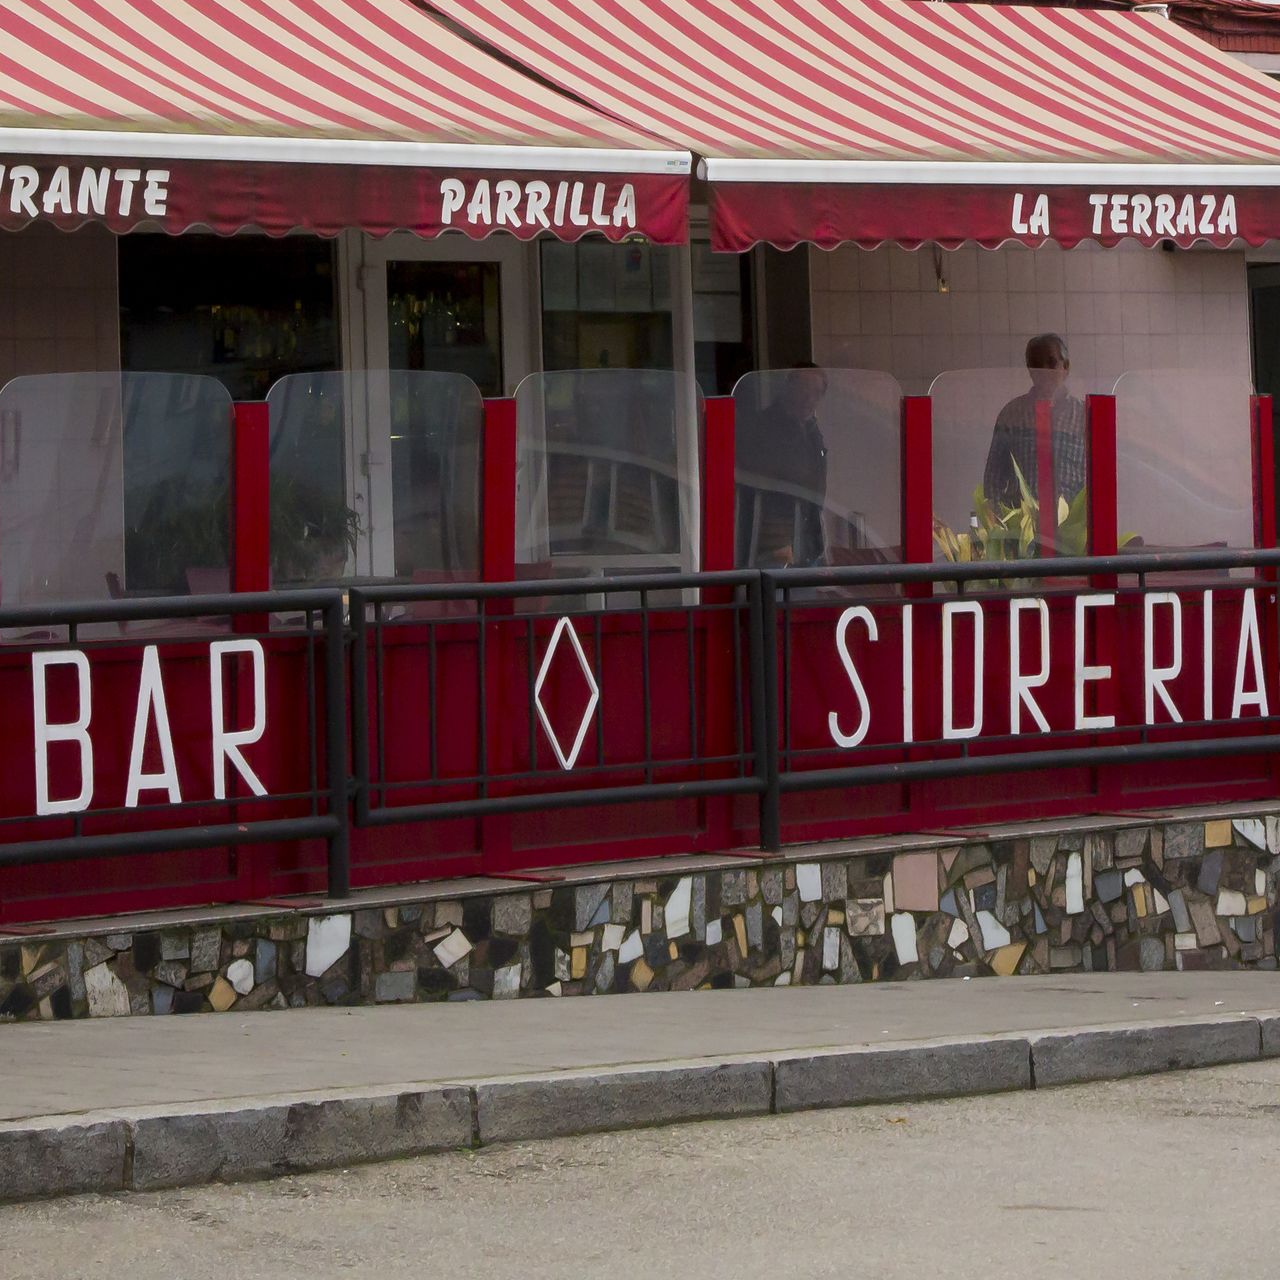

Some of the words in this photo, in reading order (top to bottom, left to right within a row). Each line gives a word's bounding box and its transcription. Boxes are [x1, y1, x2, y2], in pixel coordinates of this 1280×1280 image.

[440, 178, 637, 228] PARRILLA
[1011, 193, 1050, 236] LA
[1088, 193, 1238, 237] TERRAZA
[828, 587, 1269, 748] SIDRERIA
[31, 638, 269, 816] BAR
